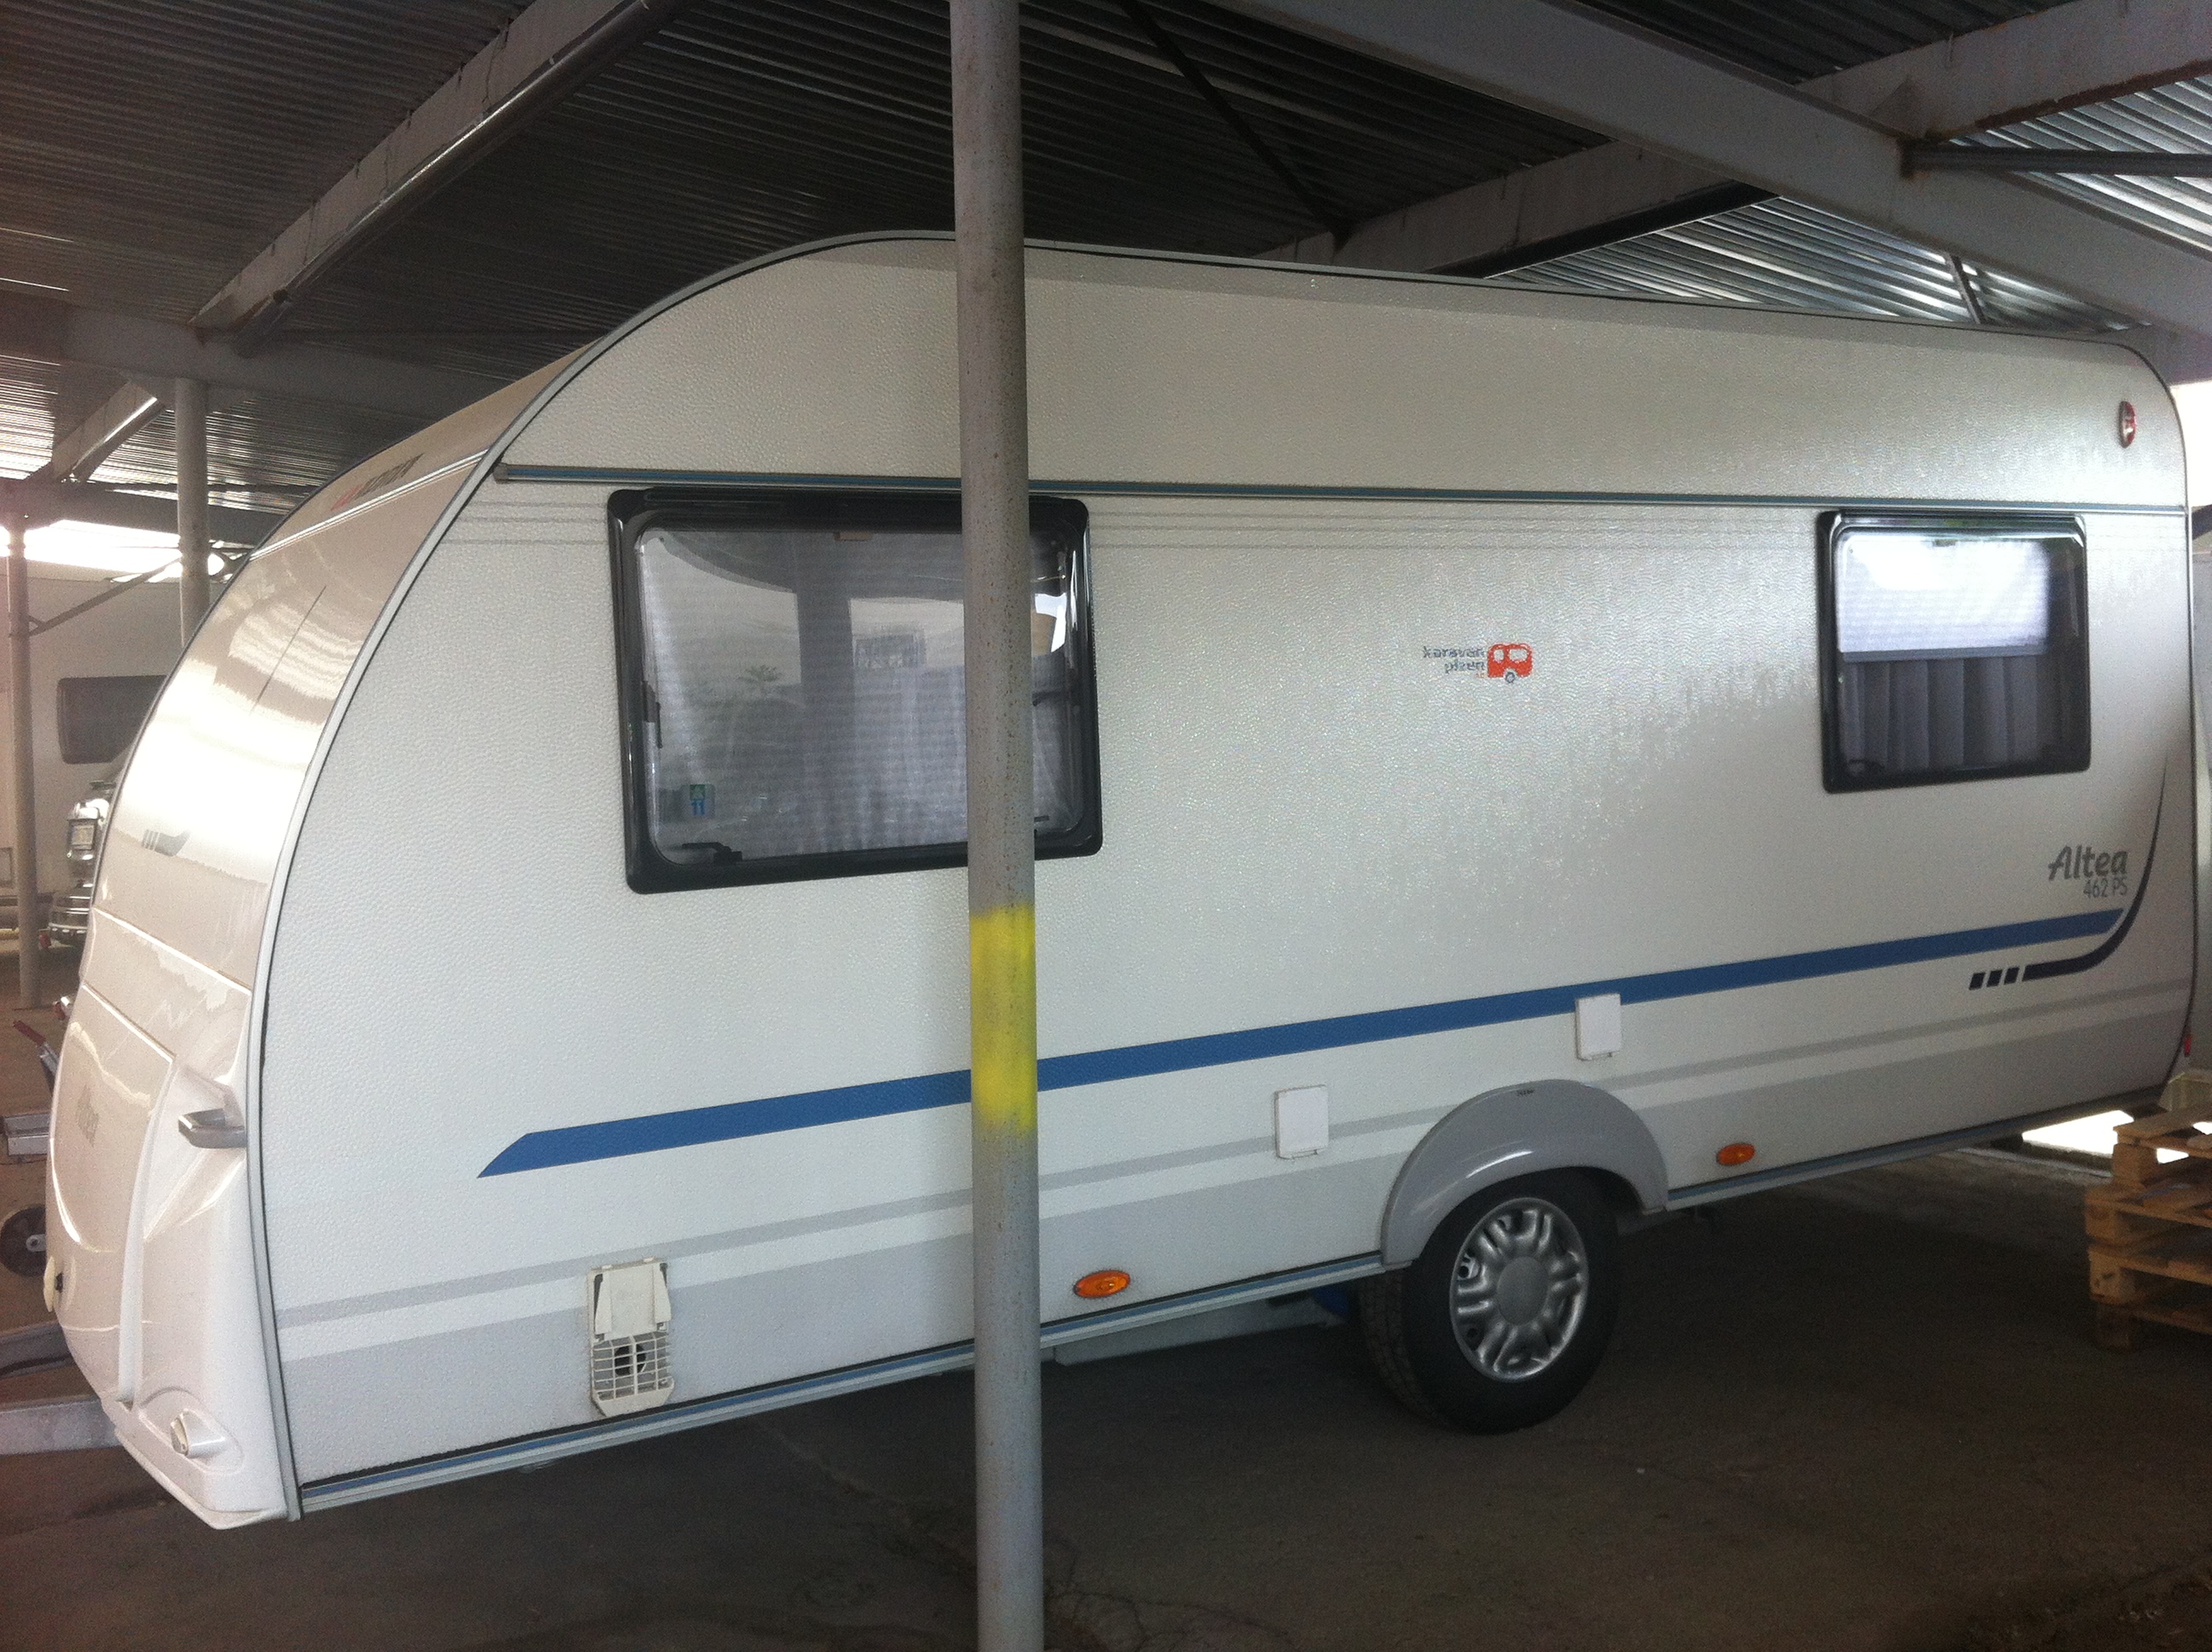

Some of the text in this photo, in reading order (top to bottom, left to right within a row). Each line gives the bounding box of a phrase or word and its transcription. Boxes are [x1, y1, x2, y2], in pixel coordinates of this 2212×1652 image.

[1423, 646, 1485, 659] karavan
[2048, 844, 2128, 881] Altea
[2083, 875, 2128, 899] 462 PS
